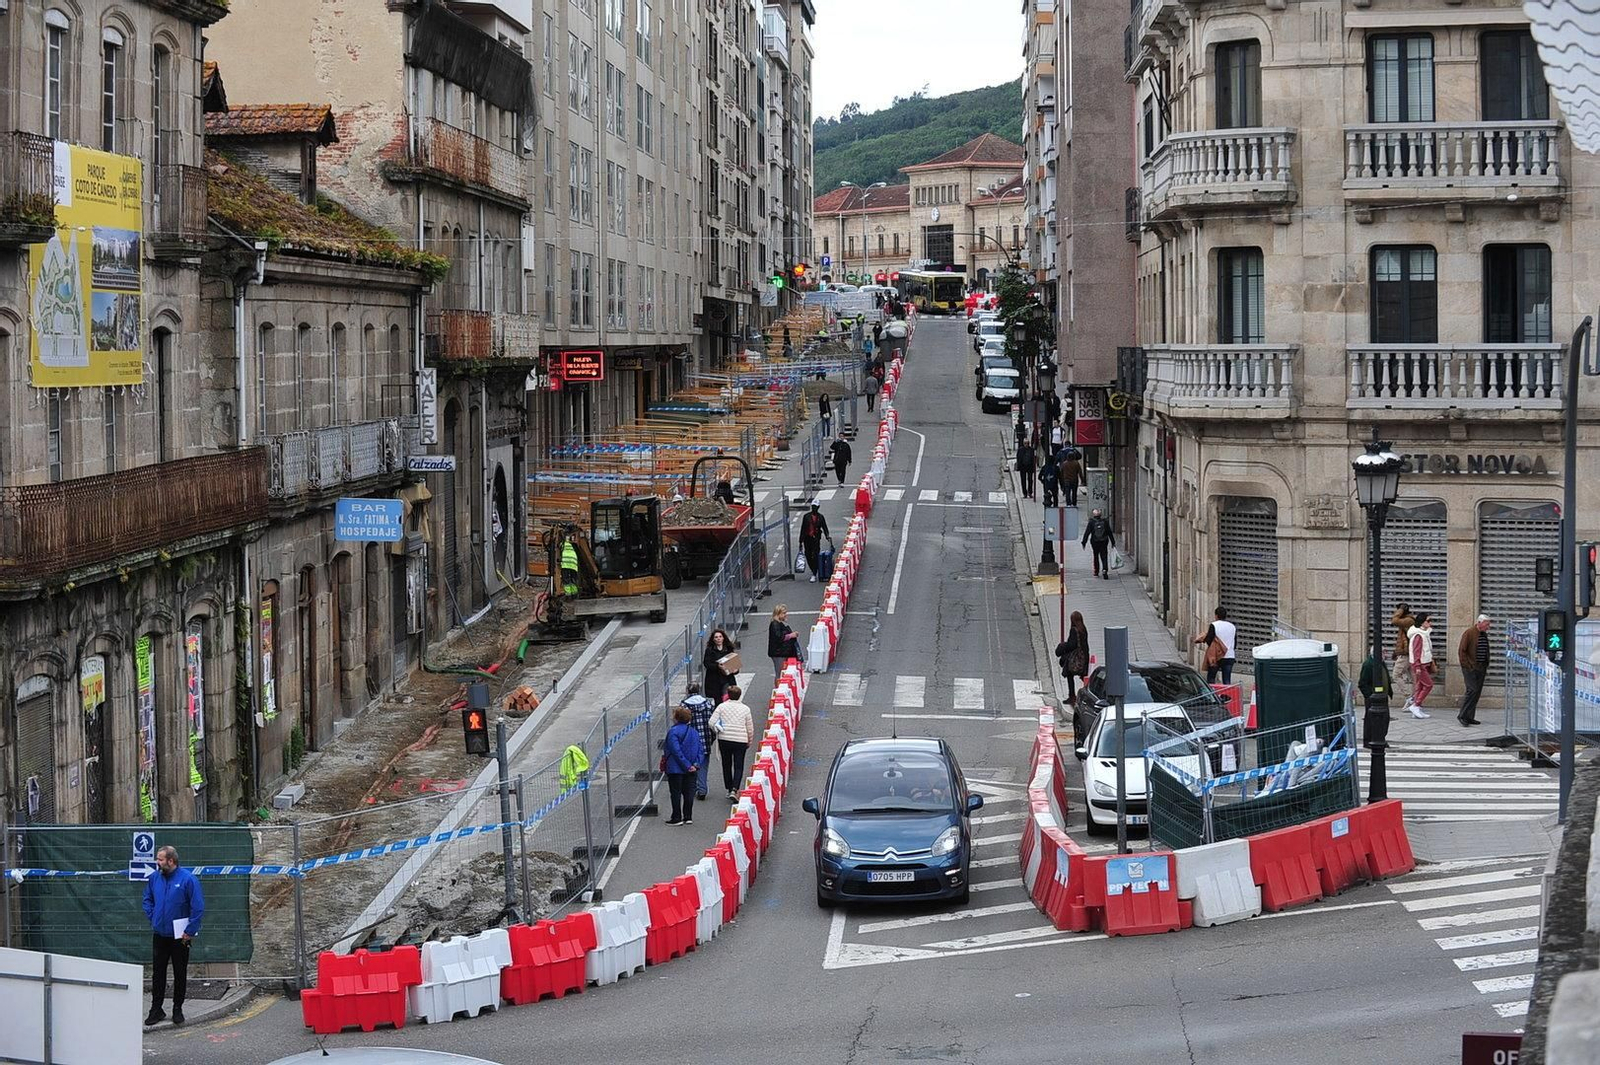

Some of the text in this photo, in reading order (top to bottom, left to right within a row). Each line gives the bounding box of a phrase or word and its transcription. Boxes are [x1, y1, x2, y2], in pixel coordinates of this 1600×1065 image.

[87, 164, 106, 181] PARQUE
[75, 179, 117, 199] COTO DE CANEDO
[823, 257, 829, 265] P
[1079, 391, 1099, 400] LOS
[421, 370, 435, 443] MAFER
[1079, 400, 1100, 409] NAR
[1079, 409, 1101, 418] DOS
[408, 458, 453, 471] Calzados
[1399, 454, 1548, 474] STOR NOVOA
[351, 504, 386, 512] BAR
[364, 514, 390, 525] FATIMA
[340, 527, 397, 537] HOSPEDAJE
[872, 872, 913, 881] 0705 HPP
[1493, 1050, 1519, 1065] OF
